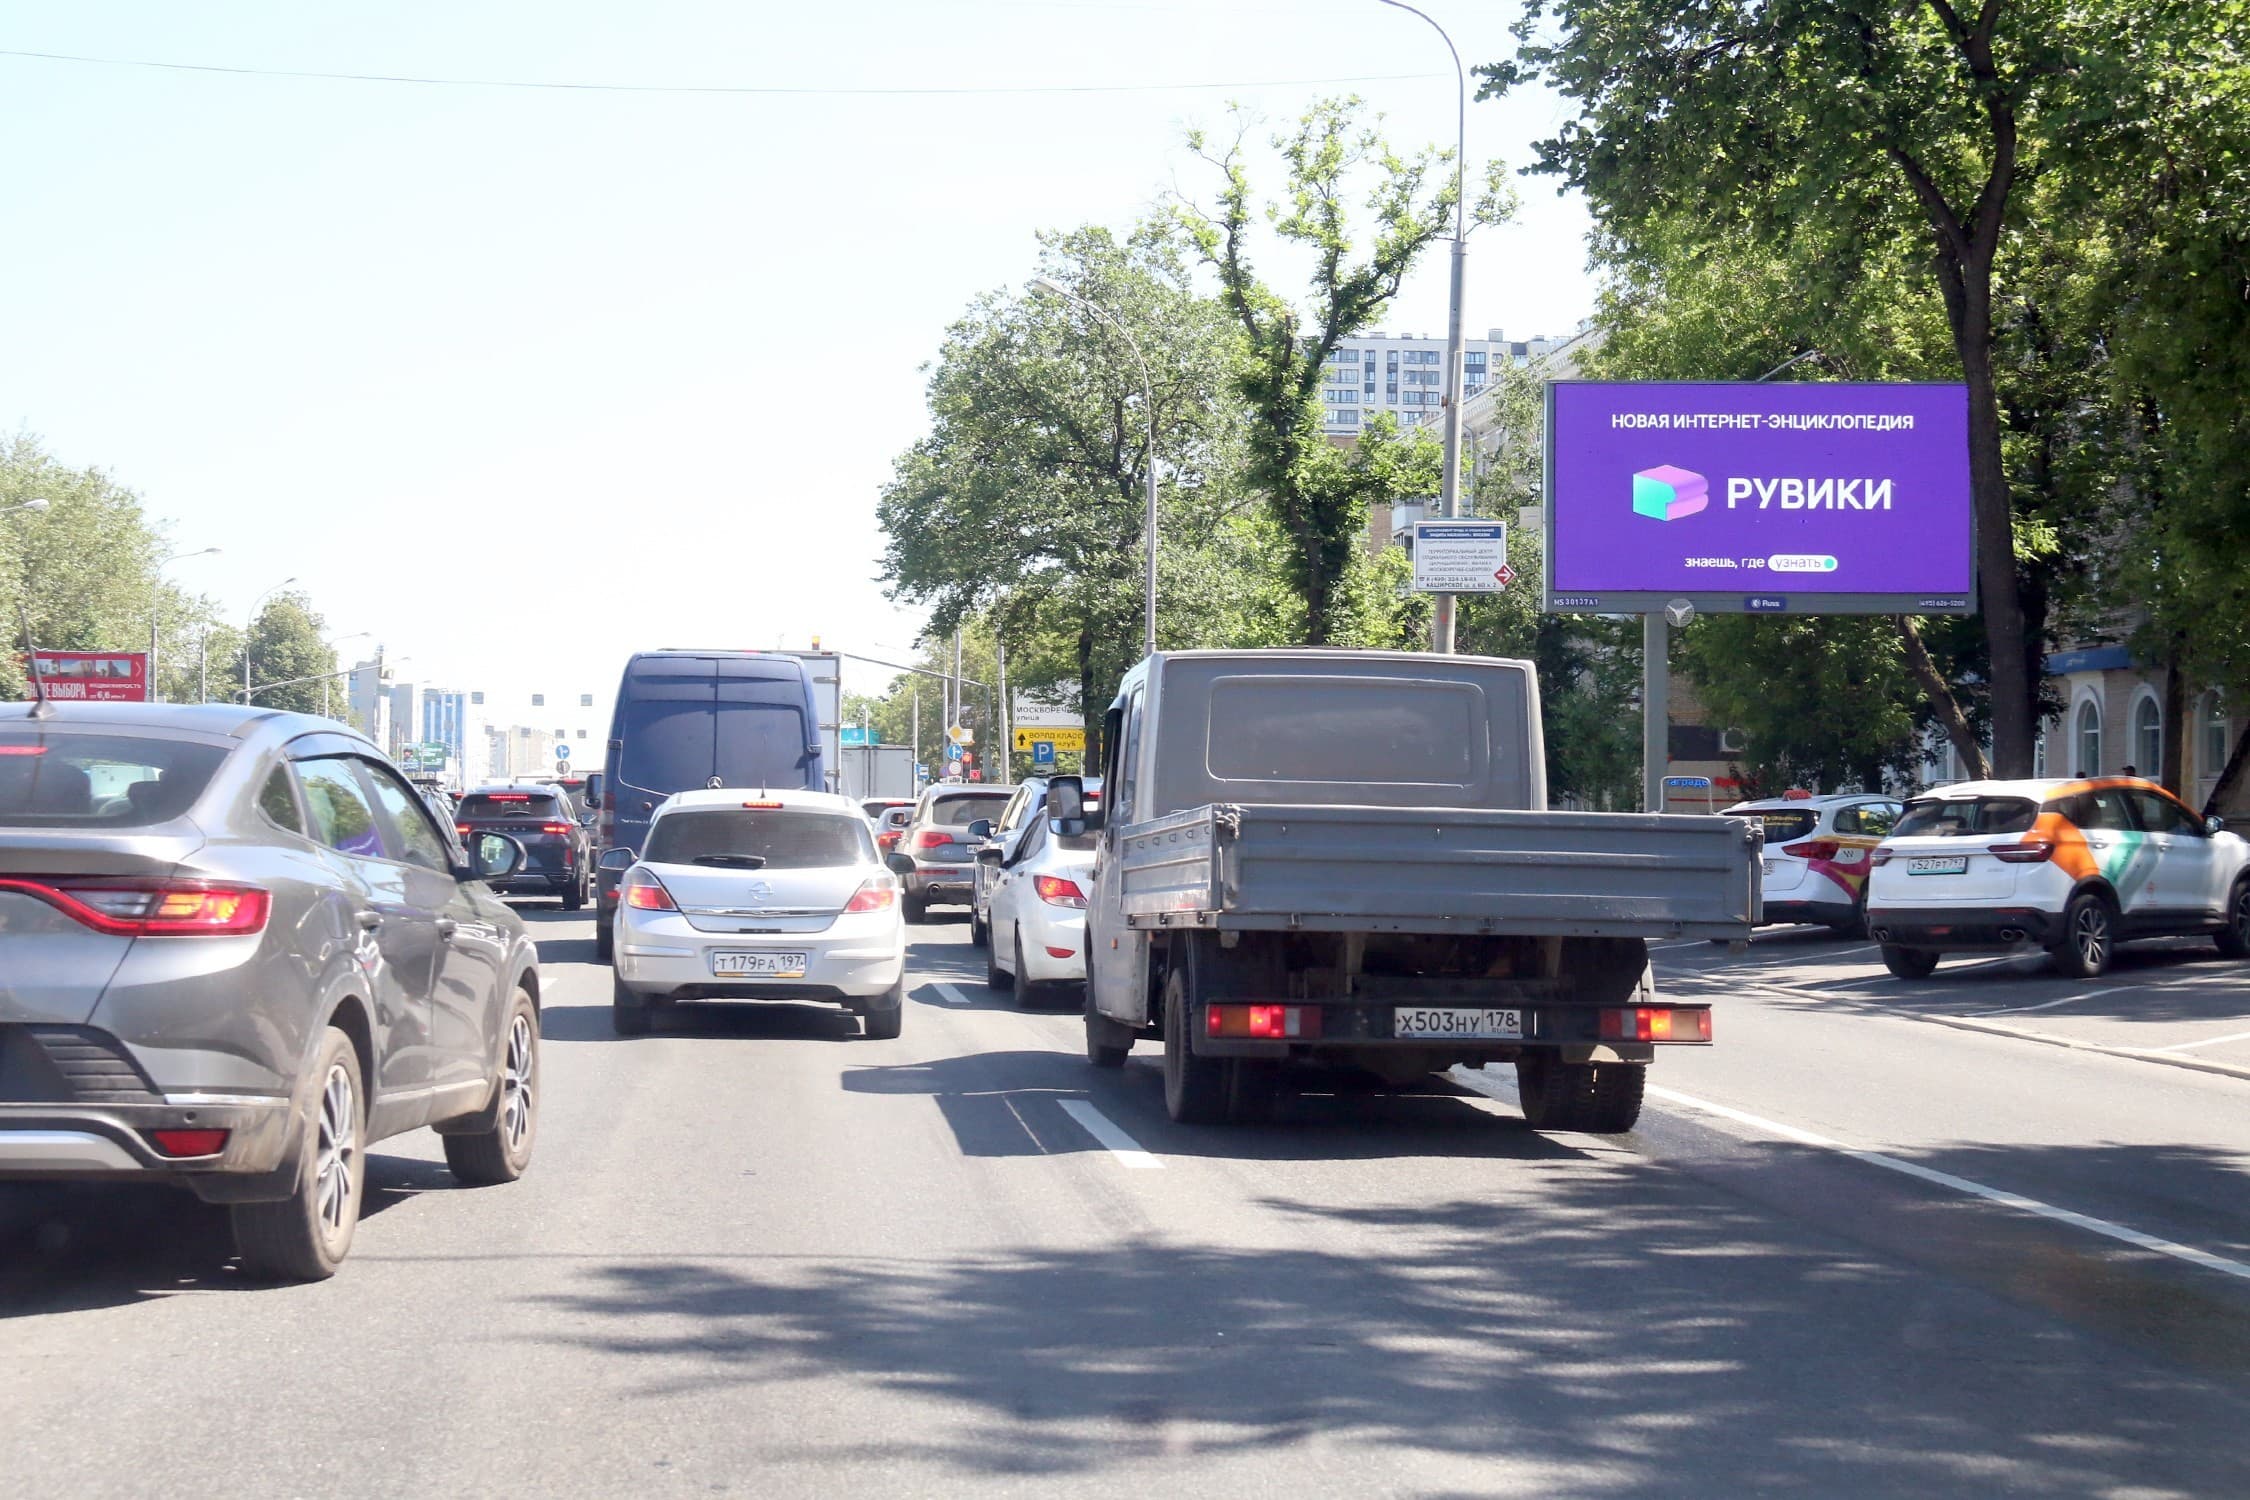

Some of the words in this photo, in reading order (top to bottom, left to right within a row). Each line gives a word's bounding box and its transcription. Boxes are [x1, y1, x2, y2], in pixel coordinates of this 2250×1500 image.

[1612, 414, 1669, 428] НОВАЯ
[1673, 414, 1914, 431] ИНТЕРНЕТ-ЭНЦИКЛОПЕДИЯ
[1727, 478, 1892, 510] РУВИКИ
[1684, 557, 1738, 569] знаешь,
[1741, 557, 1765, 569] где
[1775, 558, 1821, 569] узнать
[52, 682, 87, 698] ВЫБОРА
[719, 956, 776, 970] Т179РА
[780, 955, 801, 967] 197
[1402, 1011, 1480, 1033] Х503НУ
[1487, 1012, 1515, 1027] 178
